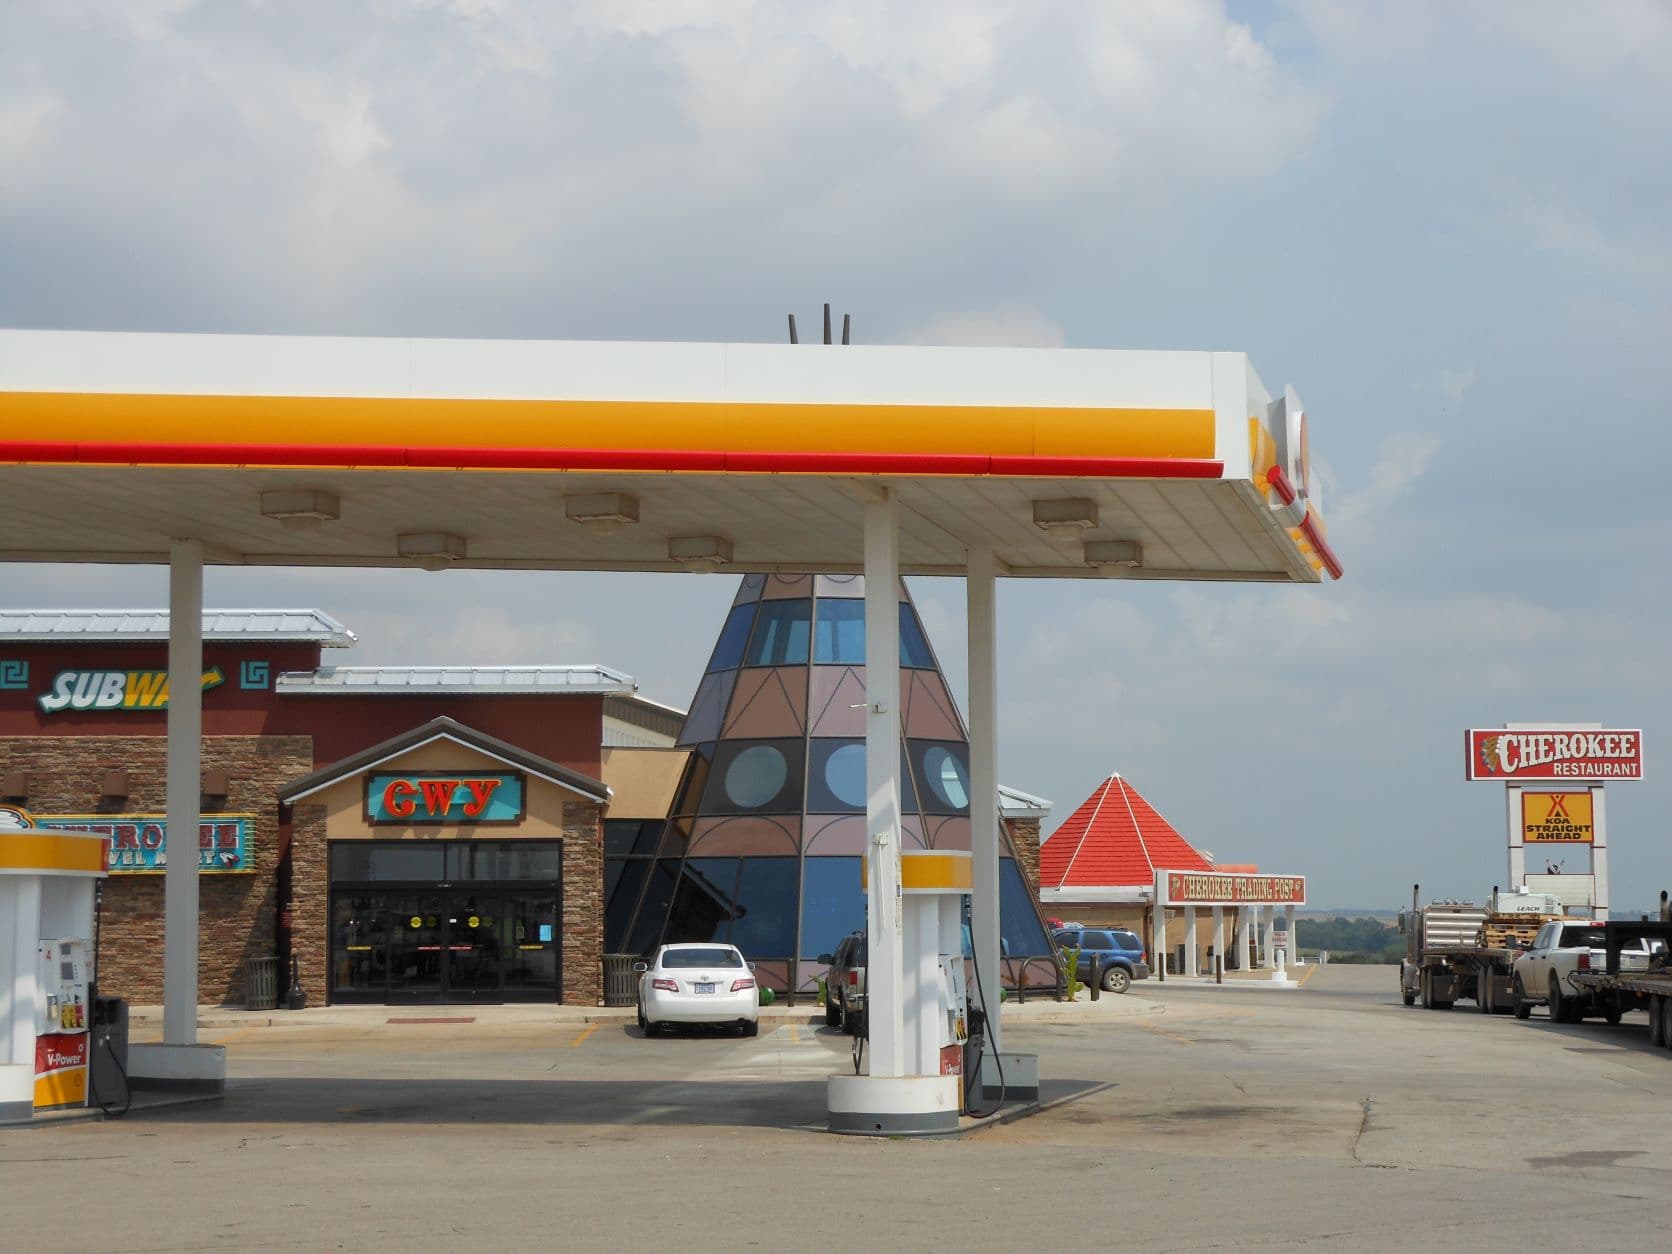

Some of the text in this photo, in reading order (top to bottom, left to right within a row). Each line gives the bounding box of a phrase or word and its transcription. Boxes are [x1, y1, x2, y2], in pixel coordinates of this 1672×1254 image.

[39, 672, 222, 709] SUBW
[1498, 734, 1635, 773] CHEROKEE
[1553, 762, 1637, 776] RESTAURANT
[46, 824, 238, 850] ROEE
[1183, 876, 1293, 900] CHEROKEE TRADING POST
